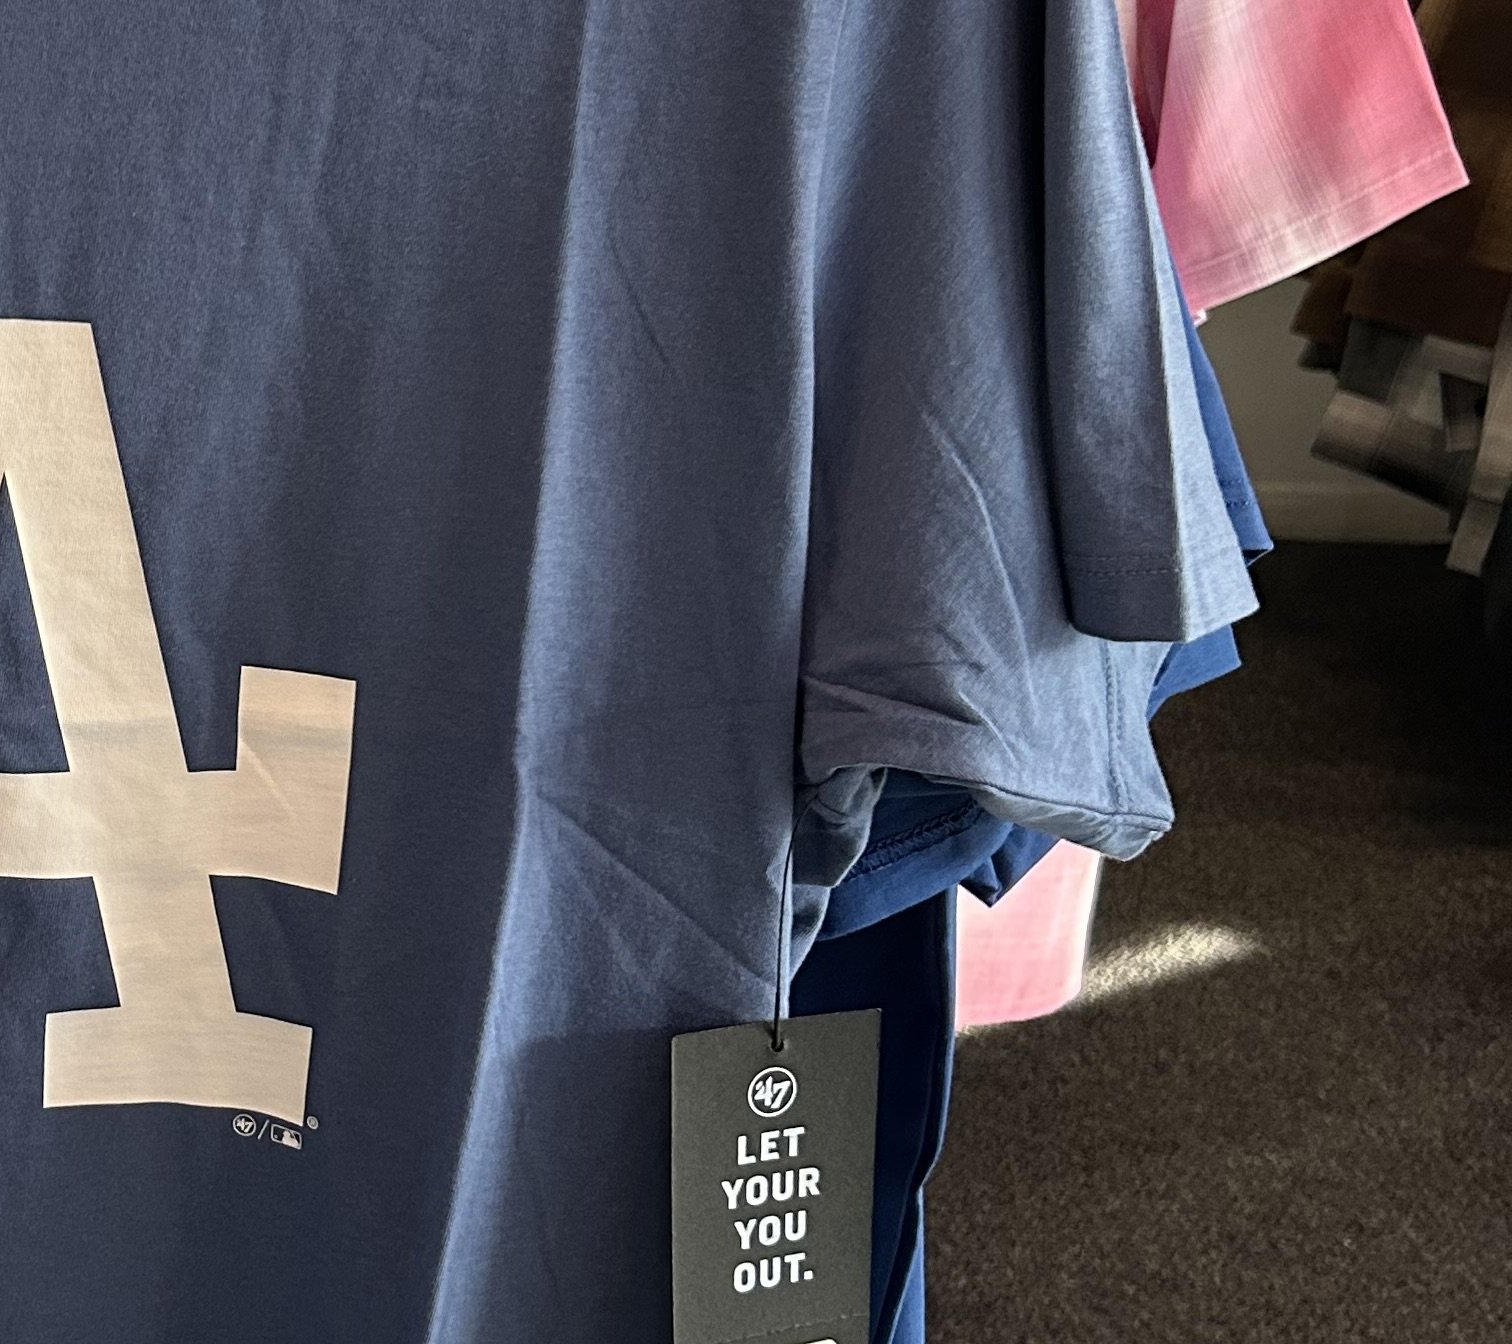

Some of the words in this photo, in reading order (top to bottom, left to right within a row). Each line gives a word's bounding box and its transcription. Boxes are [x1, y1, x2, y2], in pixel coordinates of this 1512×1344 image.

[737, 1126, 805, 1166] LET
[721, 1167, 820, 1210] YOUR
[734, 1210, 807, 1250] YOU
[733, 1252, 814, 1293] OUT.
